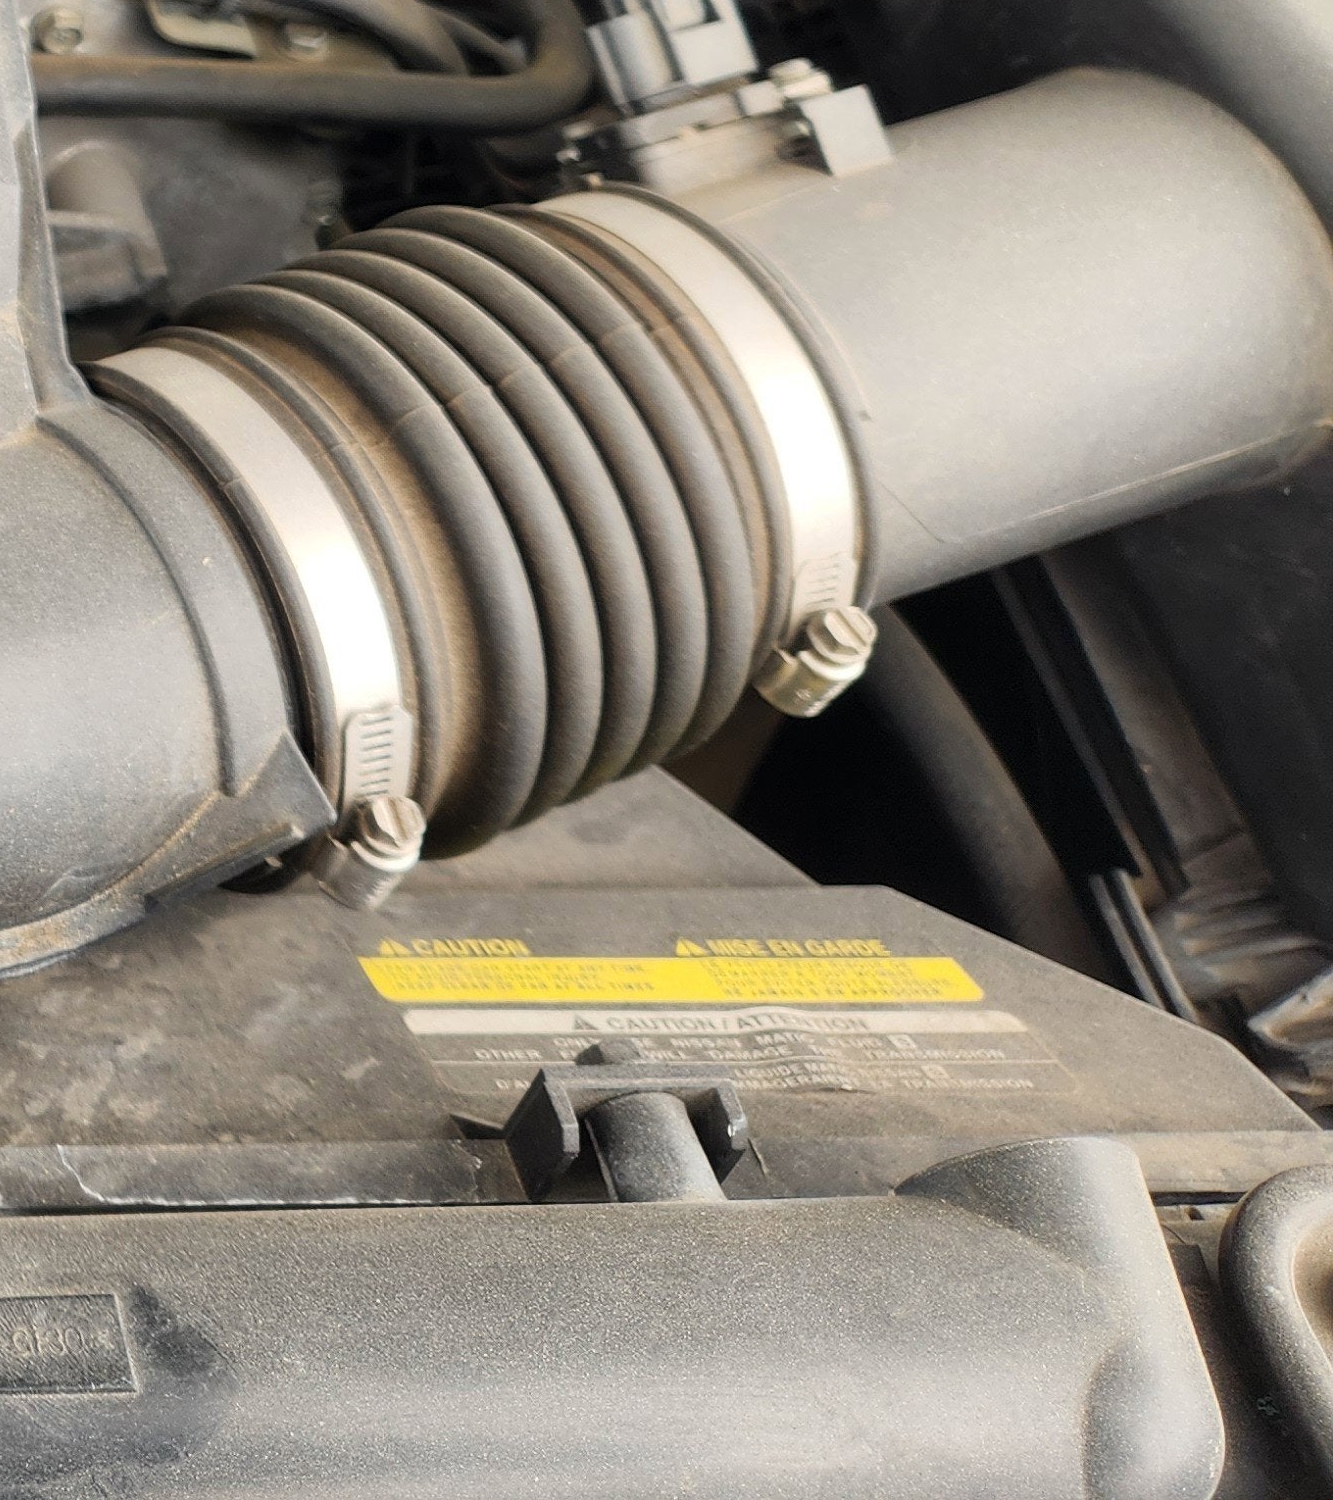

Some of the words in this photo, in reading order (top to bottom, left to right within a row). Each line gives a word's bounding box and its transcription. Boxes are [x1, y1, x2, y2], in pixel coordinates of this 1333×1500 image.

[410, 938, 531, 957] CAUTION
[805, 938, 892, 957] GARDE
[606, 1017, 716, 1031] CAUTION
[737, 1010, 870, 1031] ATTENTION
[671, 1036, 743, 1049] NISSAN
[475, 1049, 542, 1061] OTHER
[708, 1045, 793, 1061] DAMAGE
[864, 1048, 1007, 1061] TRANSMISSION
